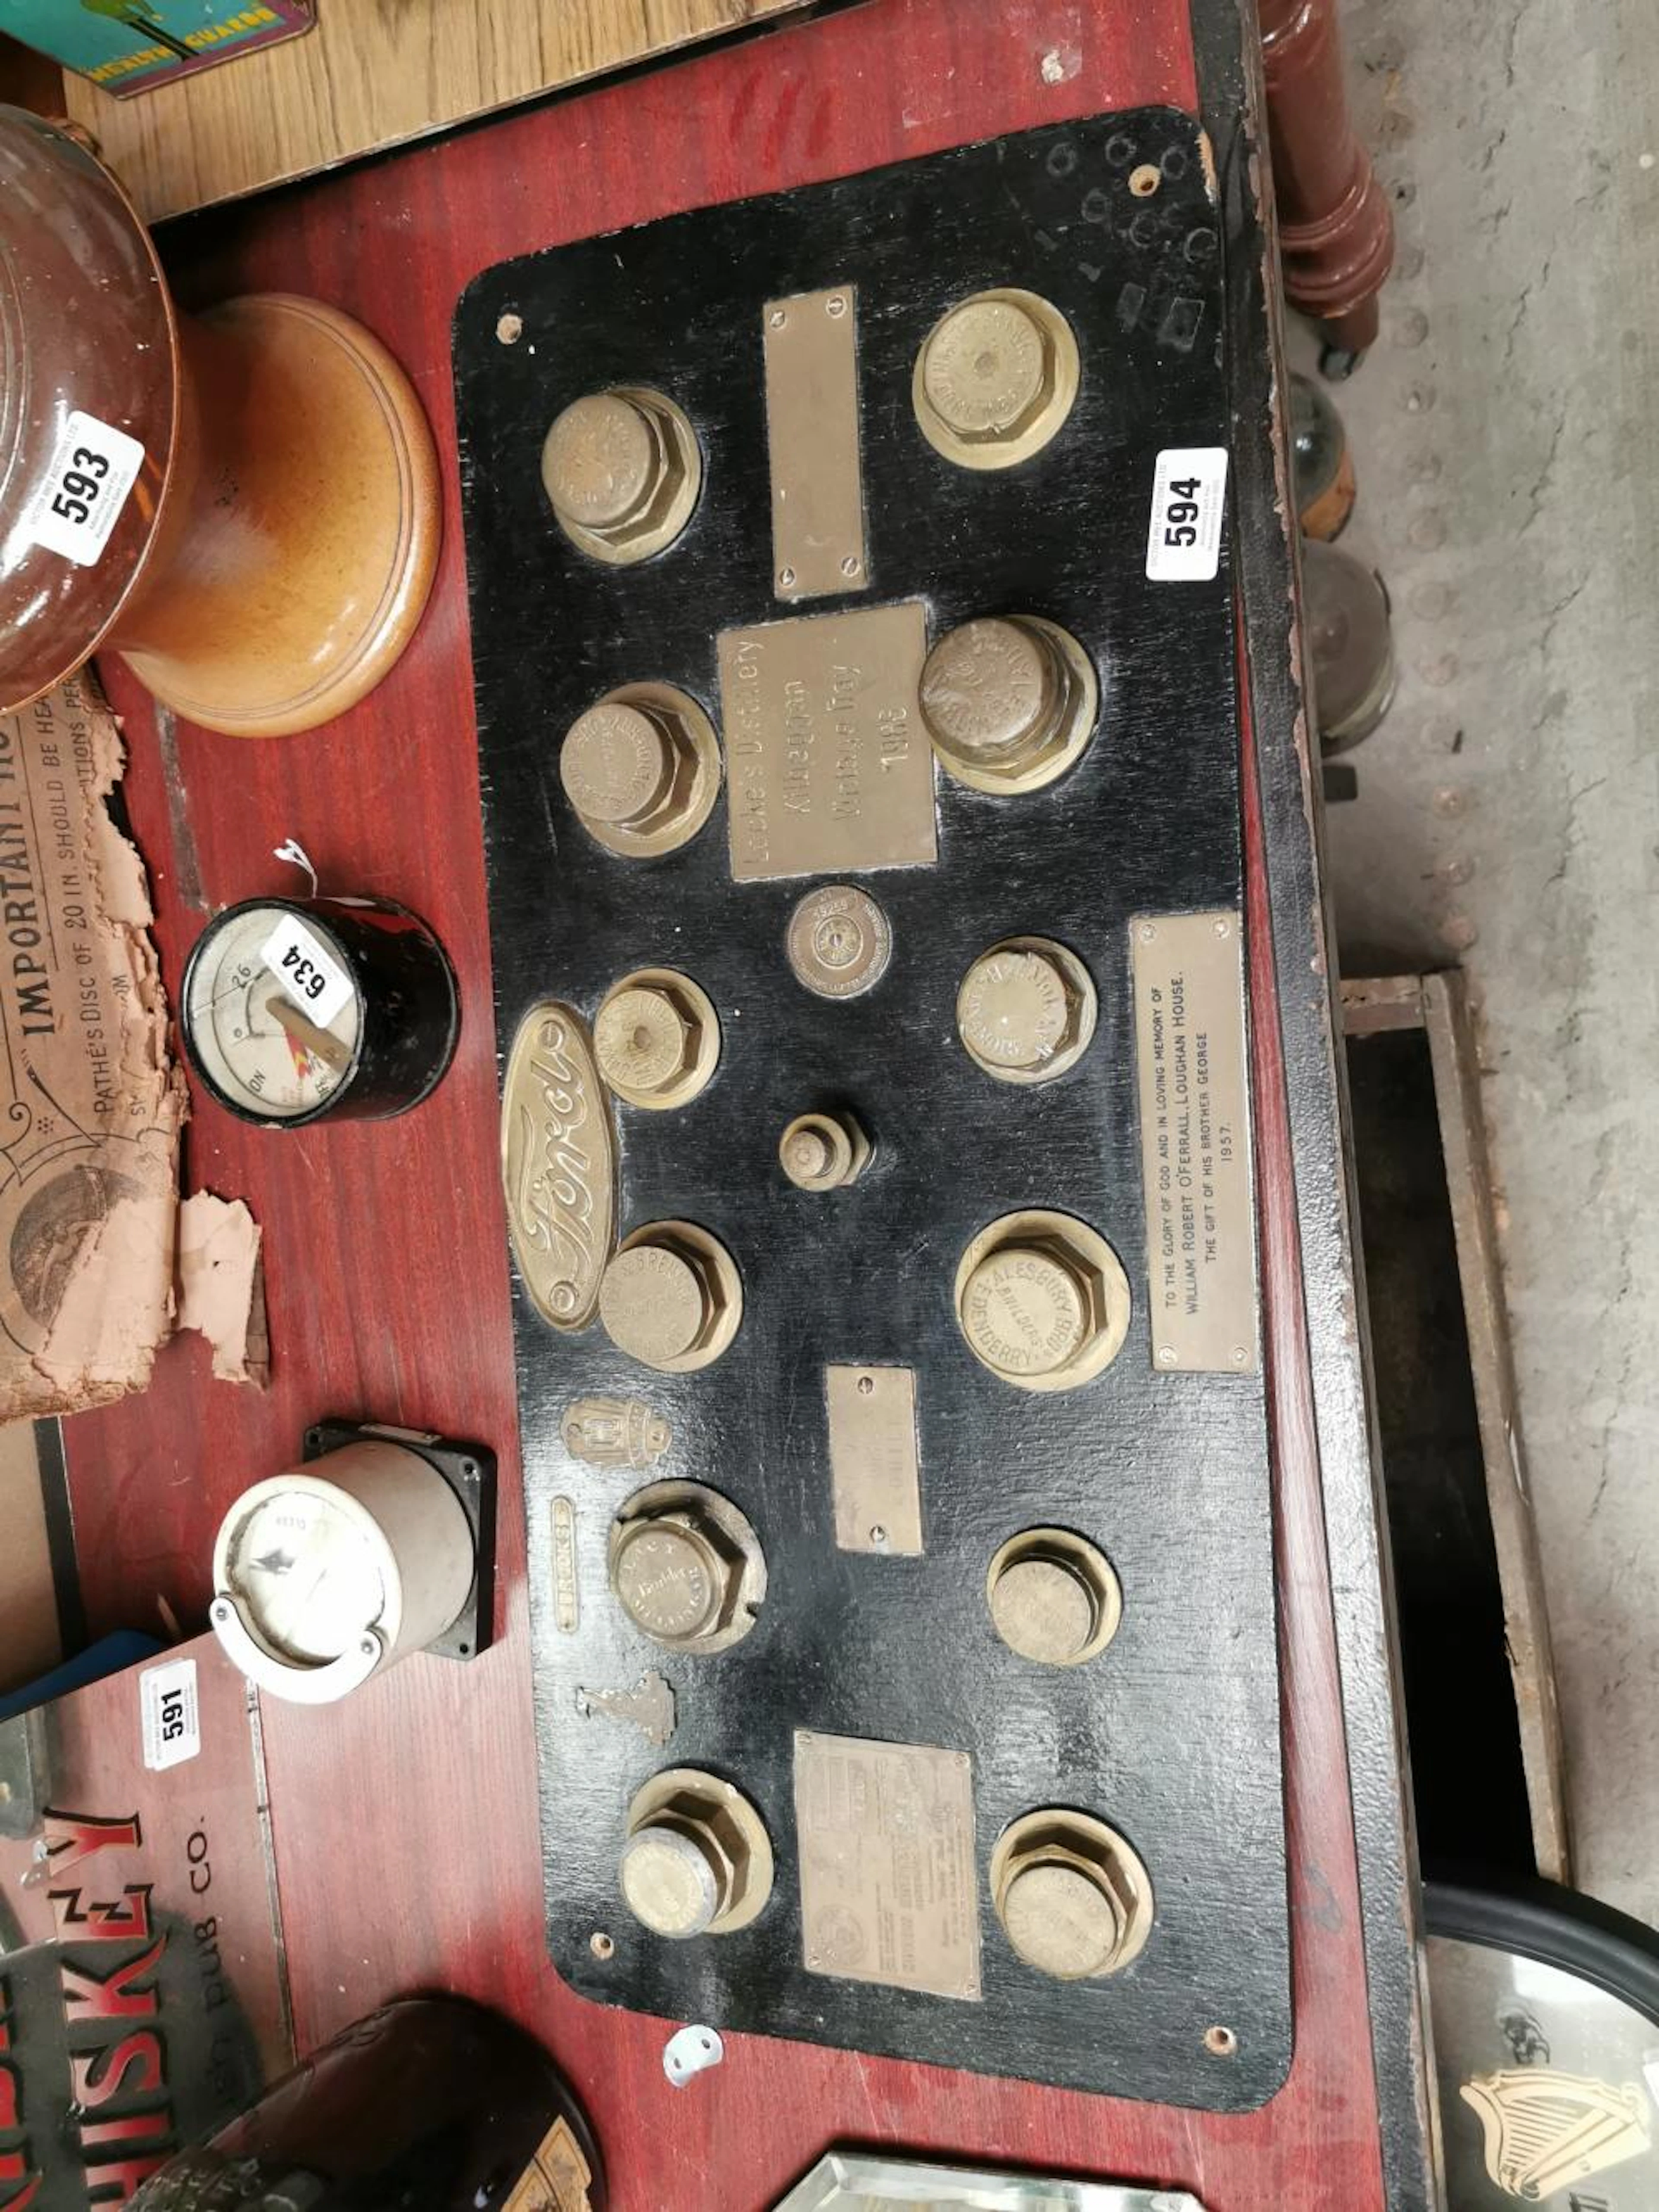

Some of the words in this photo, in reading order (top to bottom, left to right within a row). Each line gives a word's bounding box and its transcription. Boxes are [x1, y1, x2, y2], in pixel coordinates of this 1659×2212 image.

[51, 447, 109, 524] 593
[1165, 477, 1201, 547] 594
[41, 743, 61, 767] BE
[46, 780, 76, 859] SHOULD
[0, 802, 55, 1036] IMPORTANT
[63, 905, 88, 929] 20
[73, 942, 93, 965] OF
[282, 944, 325, 1000] 634
[79, 977, 102, 1022] DISC
[1151, 987, 1163, 1003] OF
[1152, 1009, 1164, 1060] MEMORY
[1173, 1035, 1189, 1104] LOUGHAN
[1196, 1032, 1208, 1084] GEORGE
[1154, 1067, 1166, 1110] LOVING
[1156, 1116, 1168, 1128] IN
[1199, 1093, 1211, 1149] BROTHER
[518, 1050, 594, 1284] Ford
[1157, 1135, 1169, 1159] AND
[1201, 1156, 1212, 1176] HIS
[1159, 1166, 1170, 1190] GOD
[1202, 1182, 1214, 1197] OF
[1160, 1197, 1172, 1212] OF
[1181, 1195, 1195, 1251] ROBERT
[1204, 1204, 1215, 1232] GIFT
[1162, 1219, 1174, 1257] GLORY
[1205, 1238, 1217, 1263] THE
[1165, 1264, 1175, 1286] THE
[1185, 1259, 1198, 1314] WILLIAM
[1165, 1292, 1176, 1309] TO
[161, 1689, 184, 1741] 591
[188, 1816, 212, 1894] CO.
